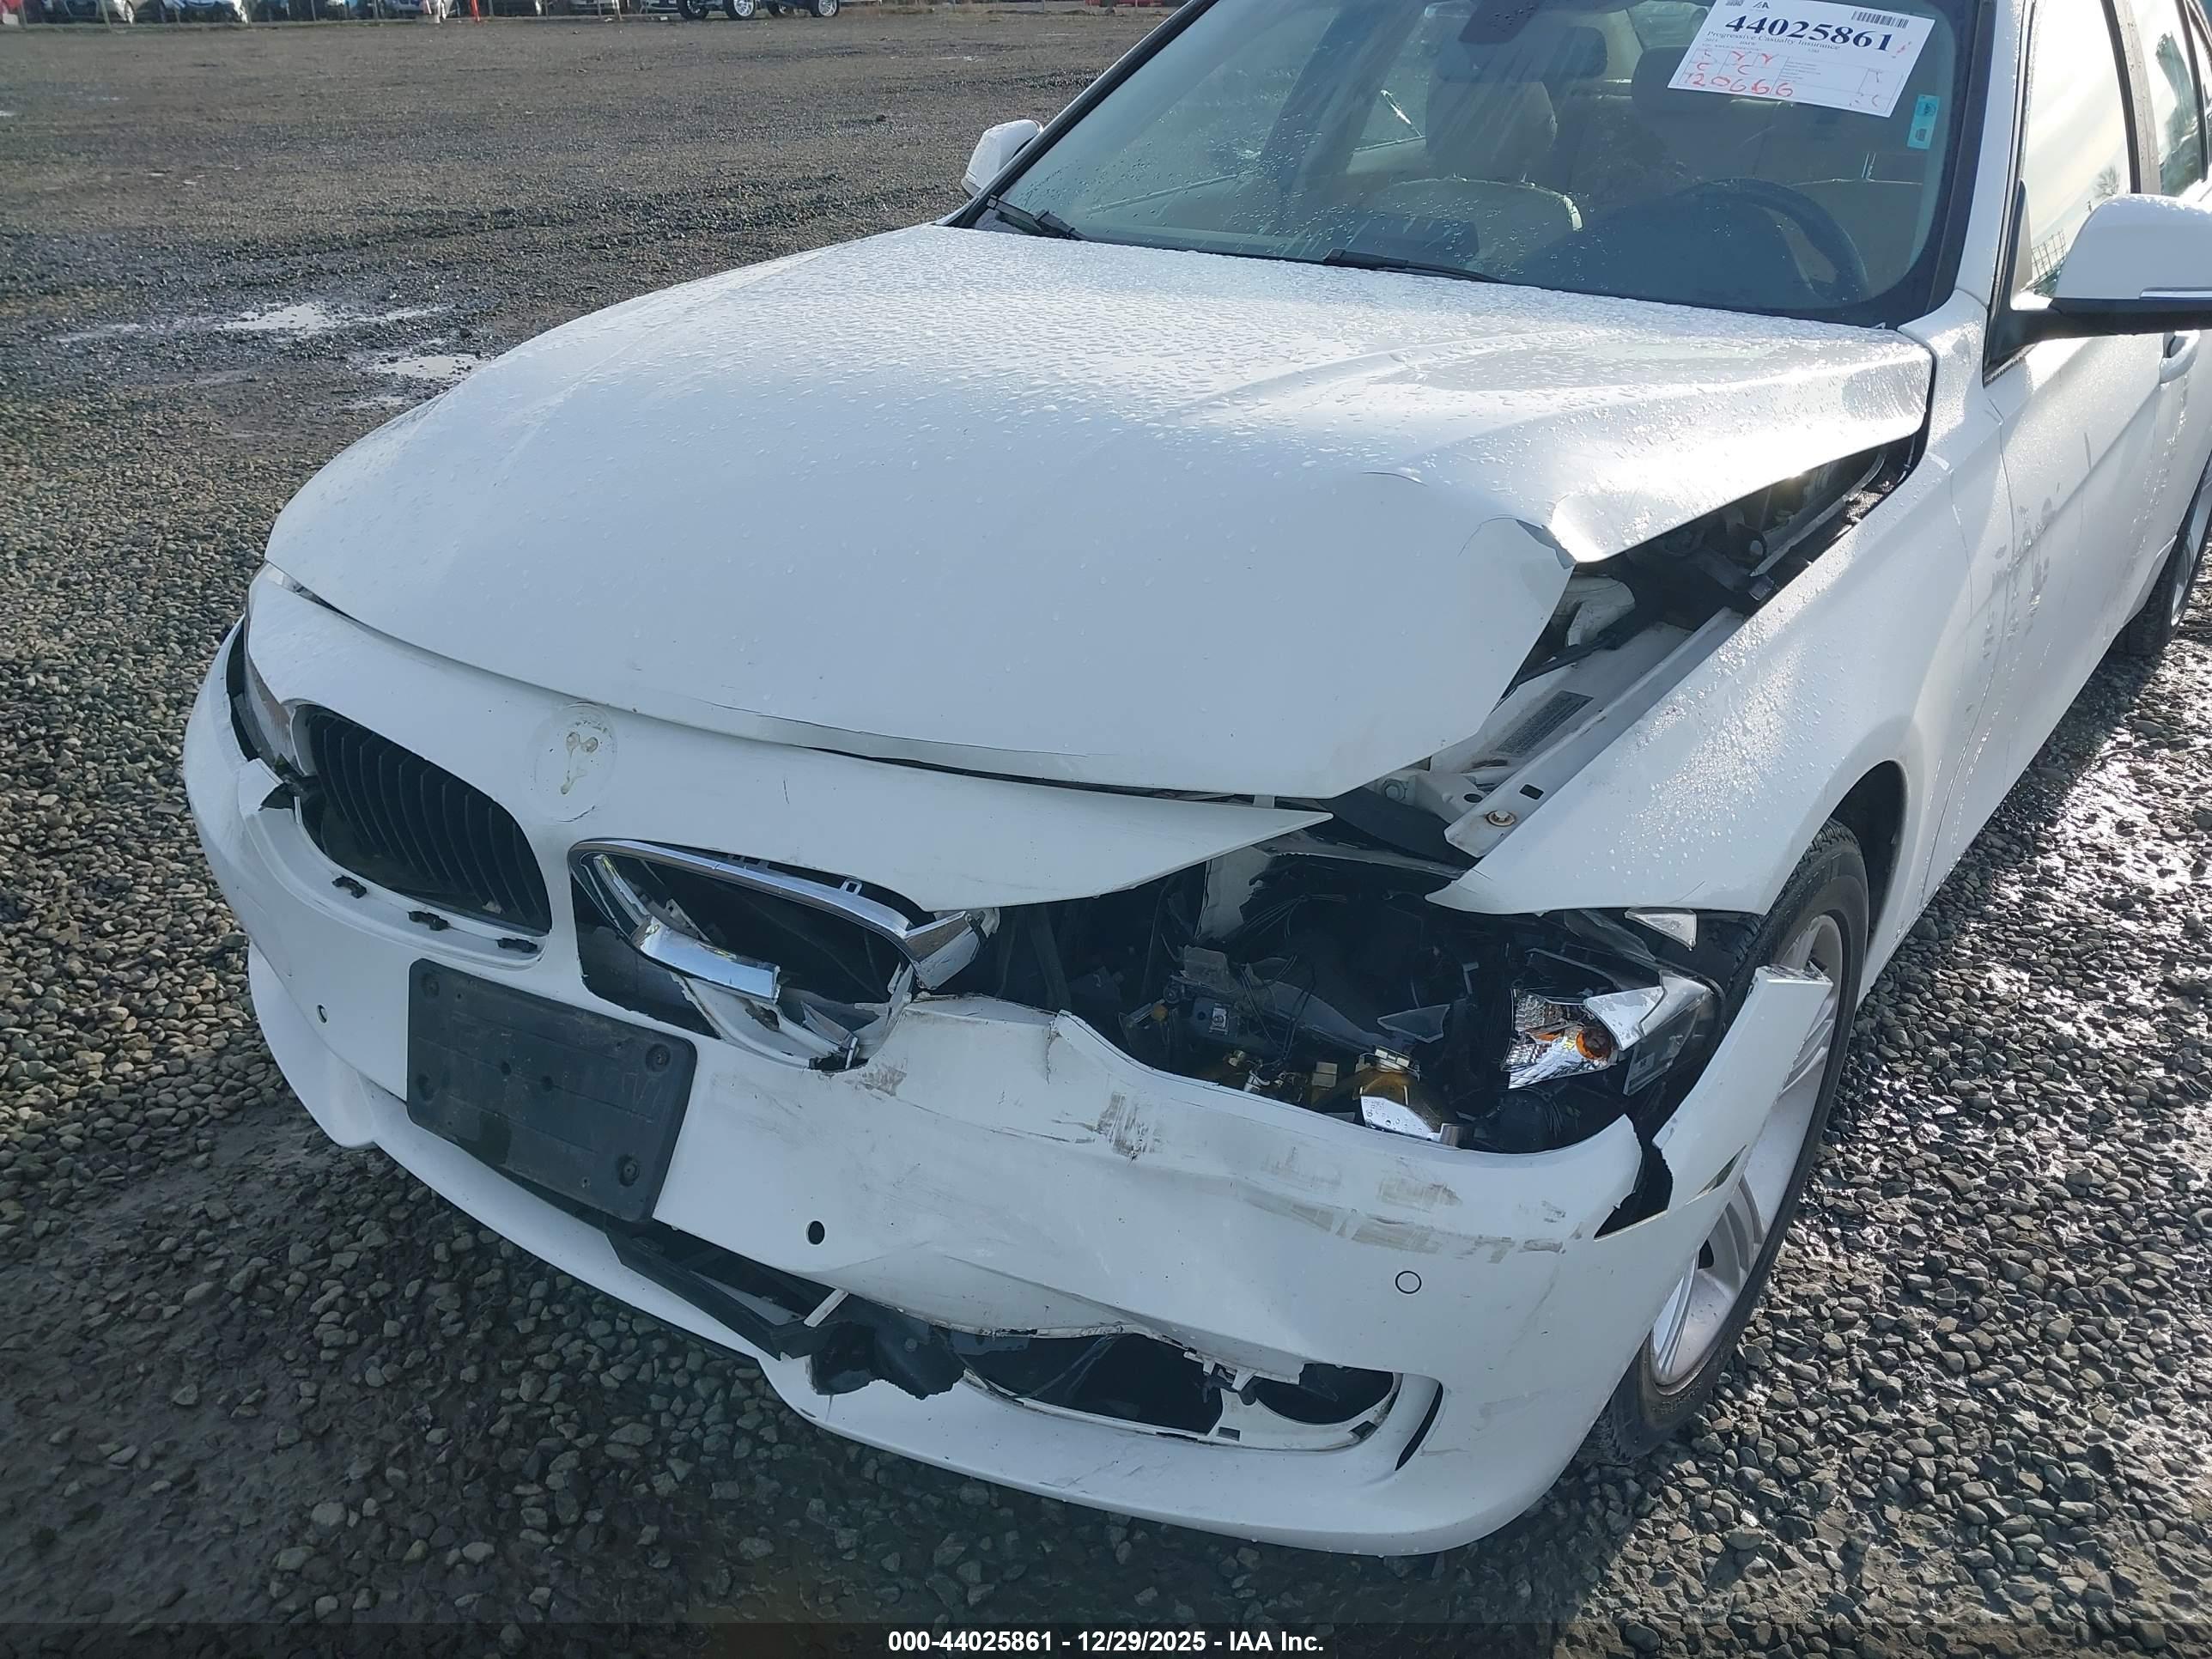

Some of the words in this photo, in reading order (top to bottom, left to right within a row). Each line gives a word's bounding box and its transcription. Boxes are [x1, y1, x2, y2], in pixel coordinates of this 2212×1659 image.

[1707, 31, 1757, 41] Progressive
[1759, 34, 1796, 45] Casualty
[1798, 39, 1841, 50] Insurance
[1725, 15, 1893, 52] 44025861
